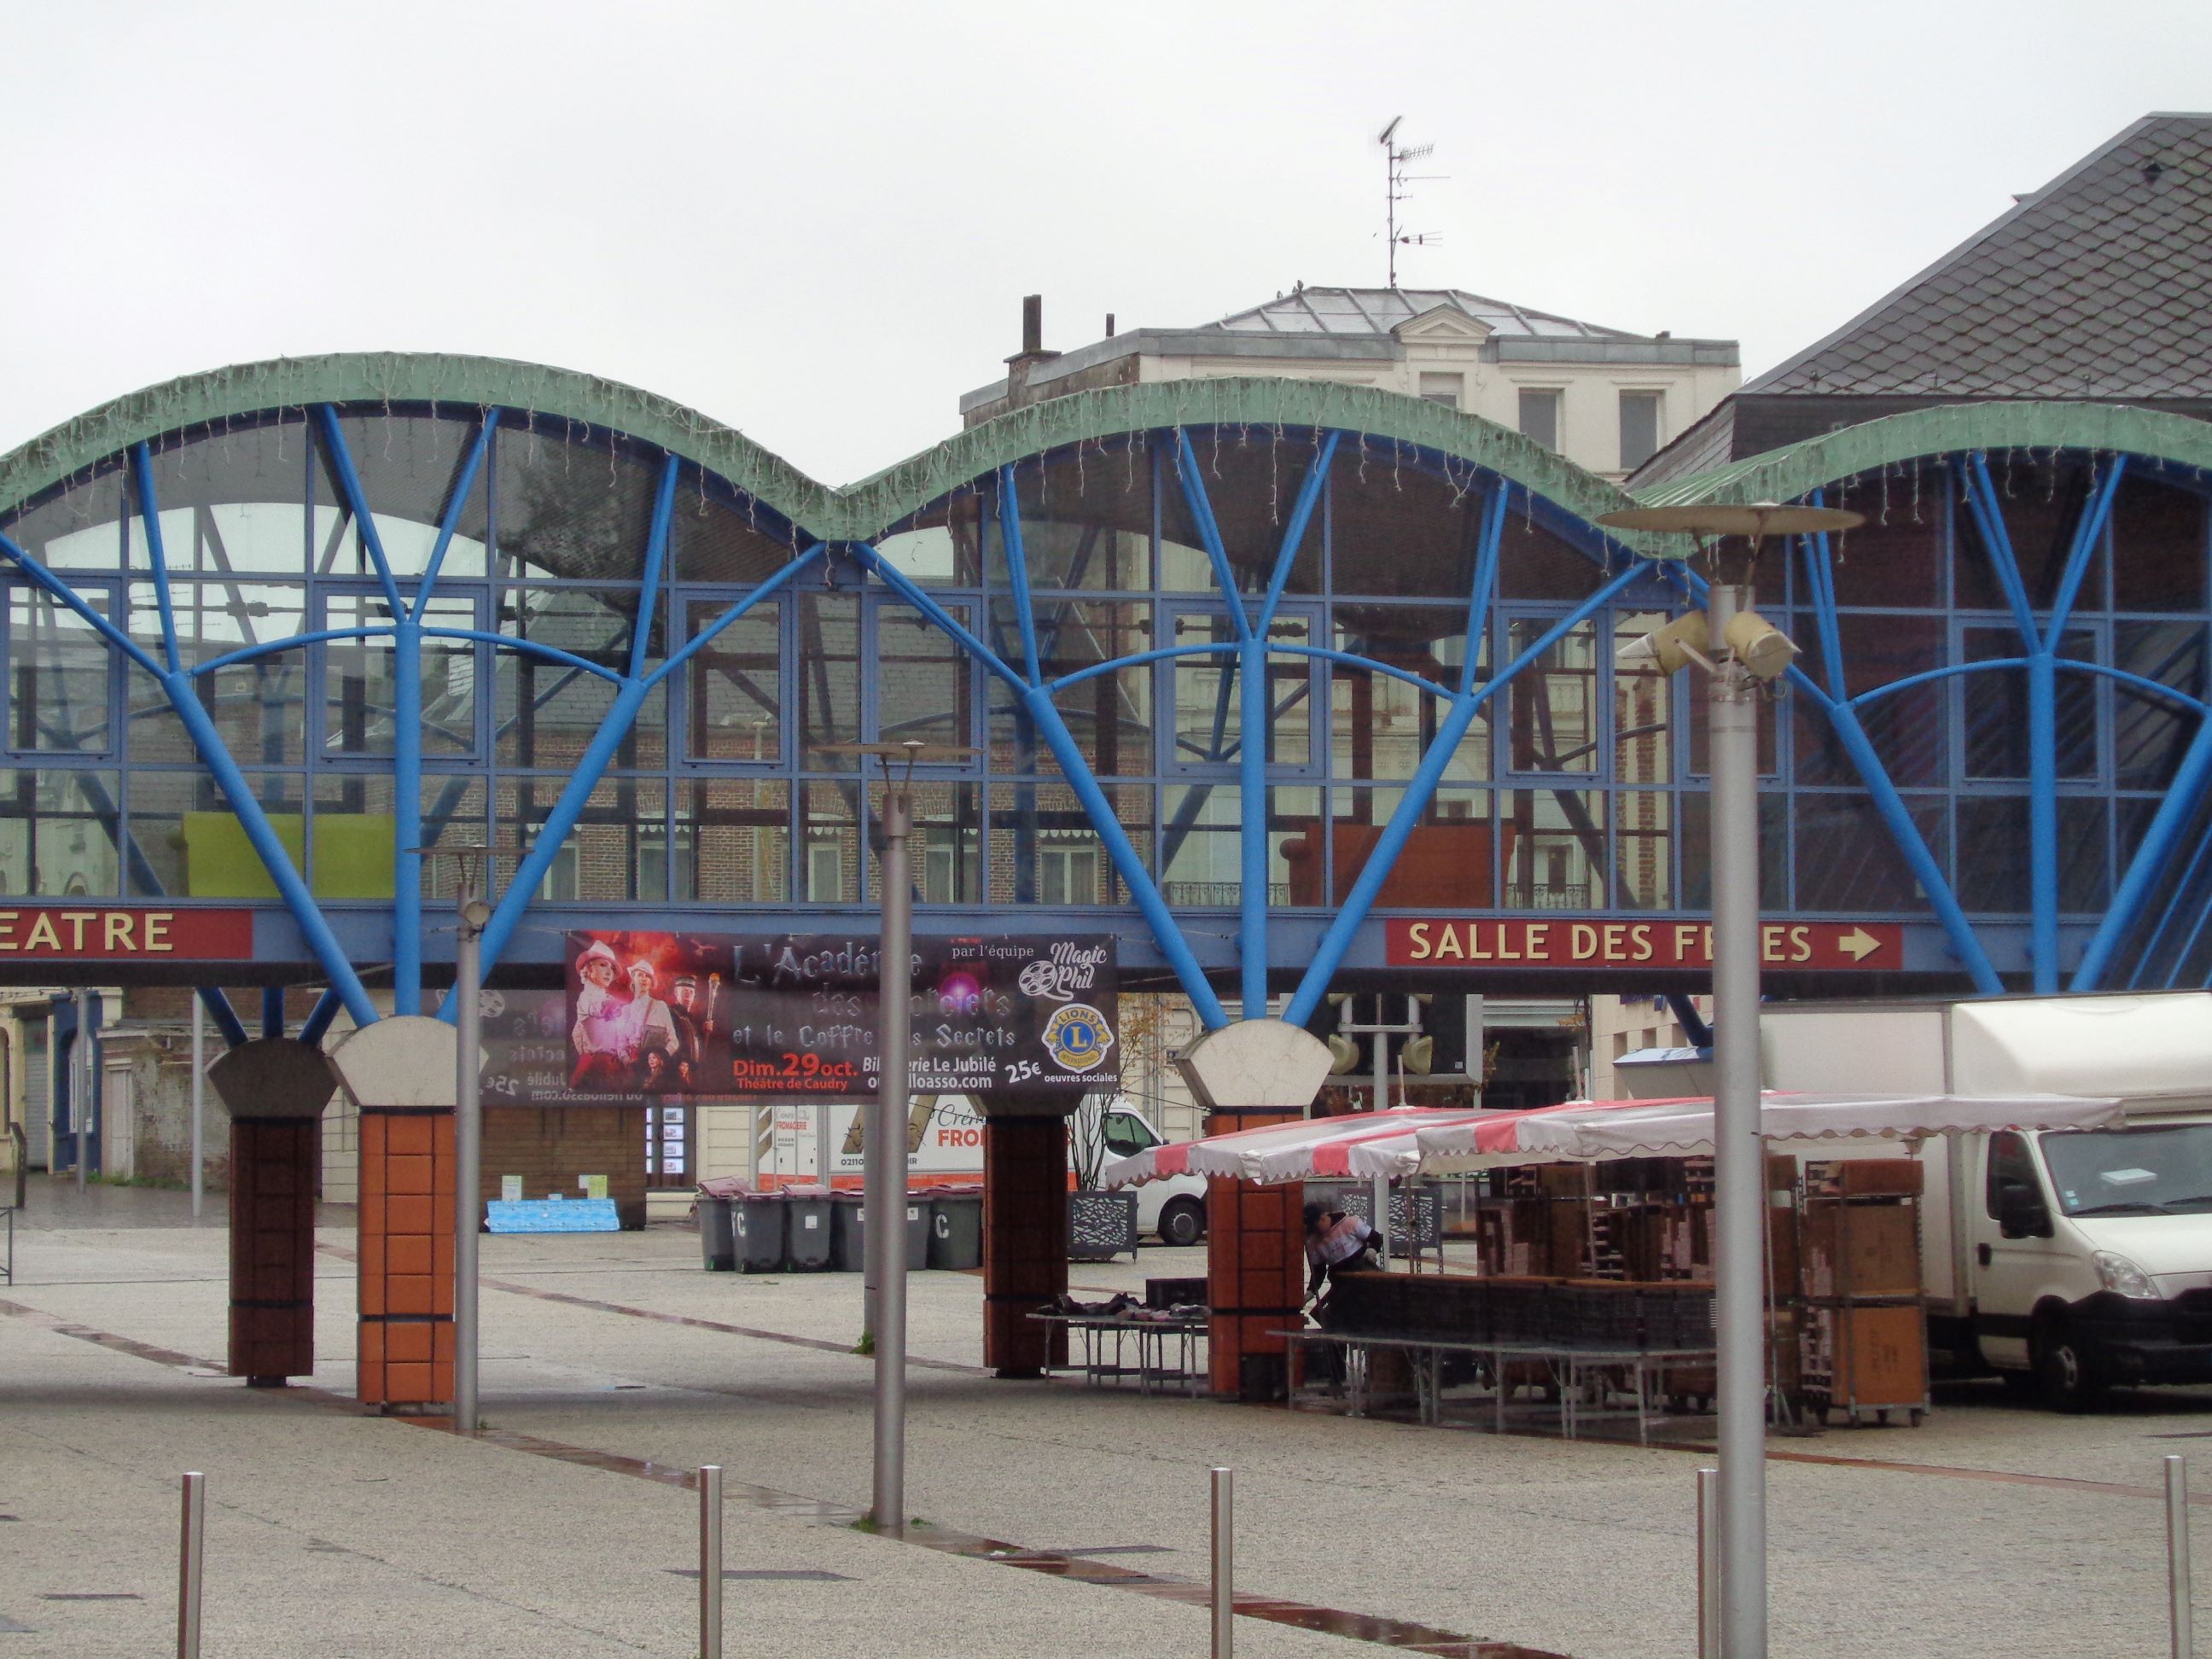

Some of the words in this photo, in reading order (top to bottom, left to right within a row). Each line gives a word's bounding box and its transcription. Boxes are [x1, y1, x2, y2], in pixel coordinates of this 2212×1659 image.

[0, 911, 174, 952] EATRE
[1409, 923, 1550, 960] SALLE
[1572, 923, 1654, 961] DES
[1675, 925, 1812, 962] FES
[952, 946, 975, 959] par
[980, 945, 1034, 959] l'équipe
[1051, 941, 1107, 969] Magic
[1057, 963, 1095, 996] Phil
[909, 987, 1011, 1017] orciers
[1058, 1010, 1097, 1023] LIONS
[732, 1025, 752, 1046] et
[766, 1024, 784, 1046] le
[799, 1024, 874, 1049] Coffre
[935, 1023, 1016, 1048] Secrets
[1071, 1026, 1088, 1049] L
[934, 1057, 950, 1072] Le
[953, 1056, 997, 1073] Jubilé
[1004, 1059, 1042, 1084] 25€
[787, 1078, 802, 1089] de
[805, 1077, 847, 1091] Caudry
[909, 1073, 992, 1089] lloasso.com
[1045, 1074, 1080, 1083] oeuvres
[1081, 1073, 1118, 1083] sociales
